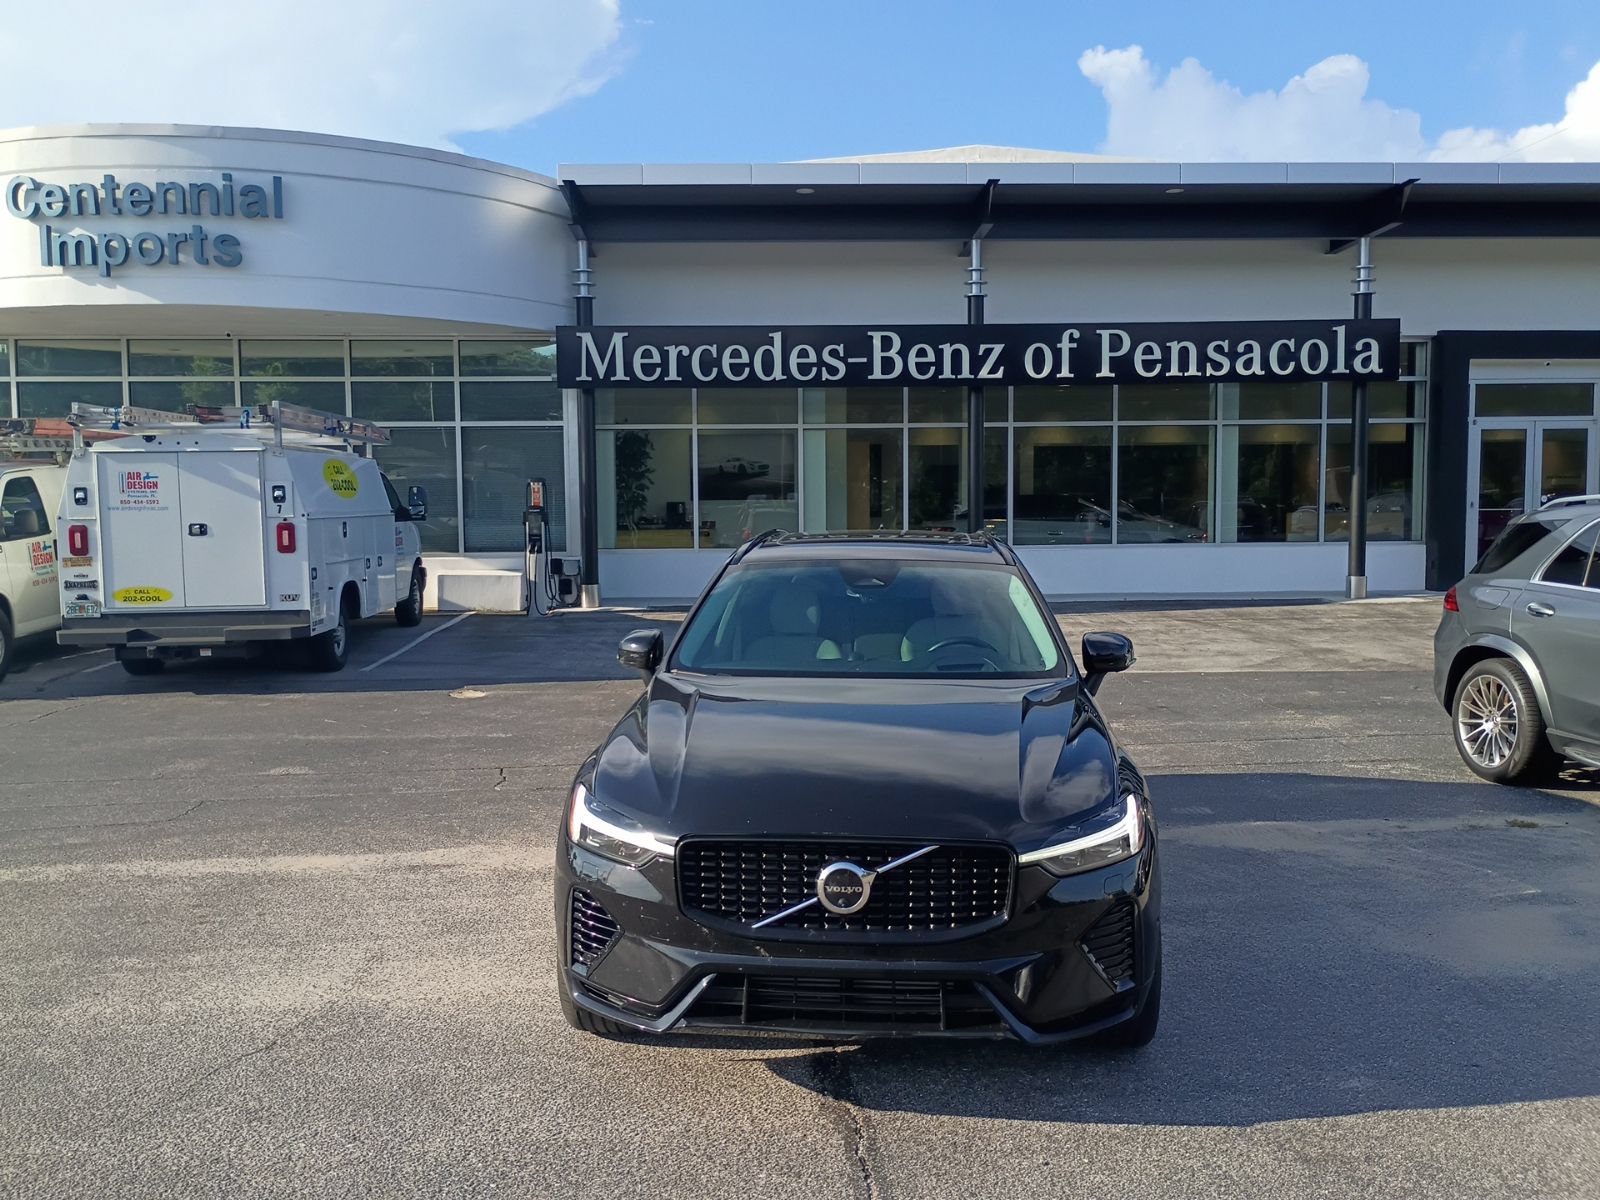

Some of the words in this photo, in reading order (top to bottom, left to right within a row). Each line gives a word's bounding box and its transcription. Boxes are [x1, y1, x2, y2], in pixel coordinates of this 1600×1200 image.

[6, 173, 284, 219] Centennial
[40, 225, 243, 277] Imports
[576, 331, 1005, 381] Mercedes-Benz
[1024, 329, 1080, 379] of
[1095, 325, 1384, 378] Pensacola
[127, 472, 142, 480] AIR
[333, 465, 345, 475] CALL
[127, 481, 158, 490] DESIGN
[331, 479, 357, 491] 202-COOL
[276, 504, 282, 514] 7
[32, 541, 42, 553] AIR
[33, 552, 54, 566] DESIGN
[825, 885, 862, 893] VOLVO
